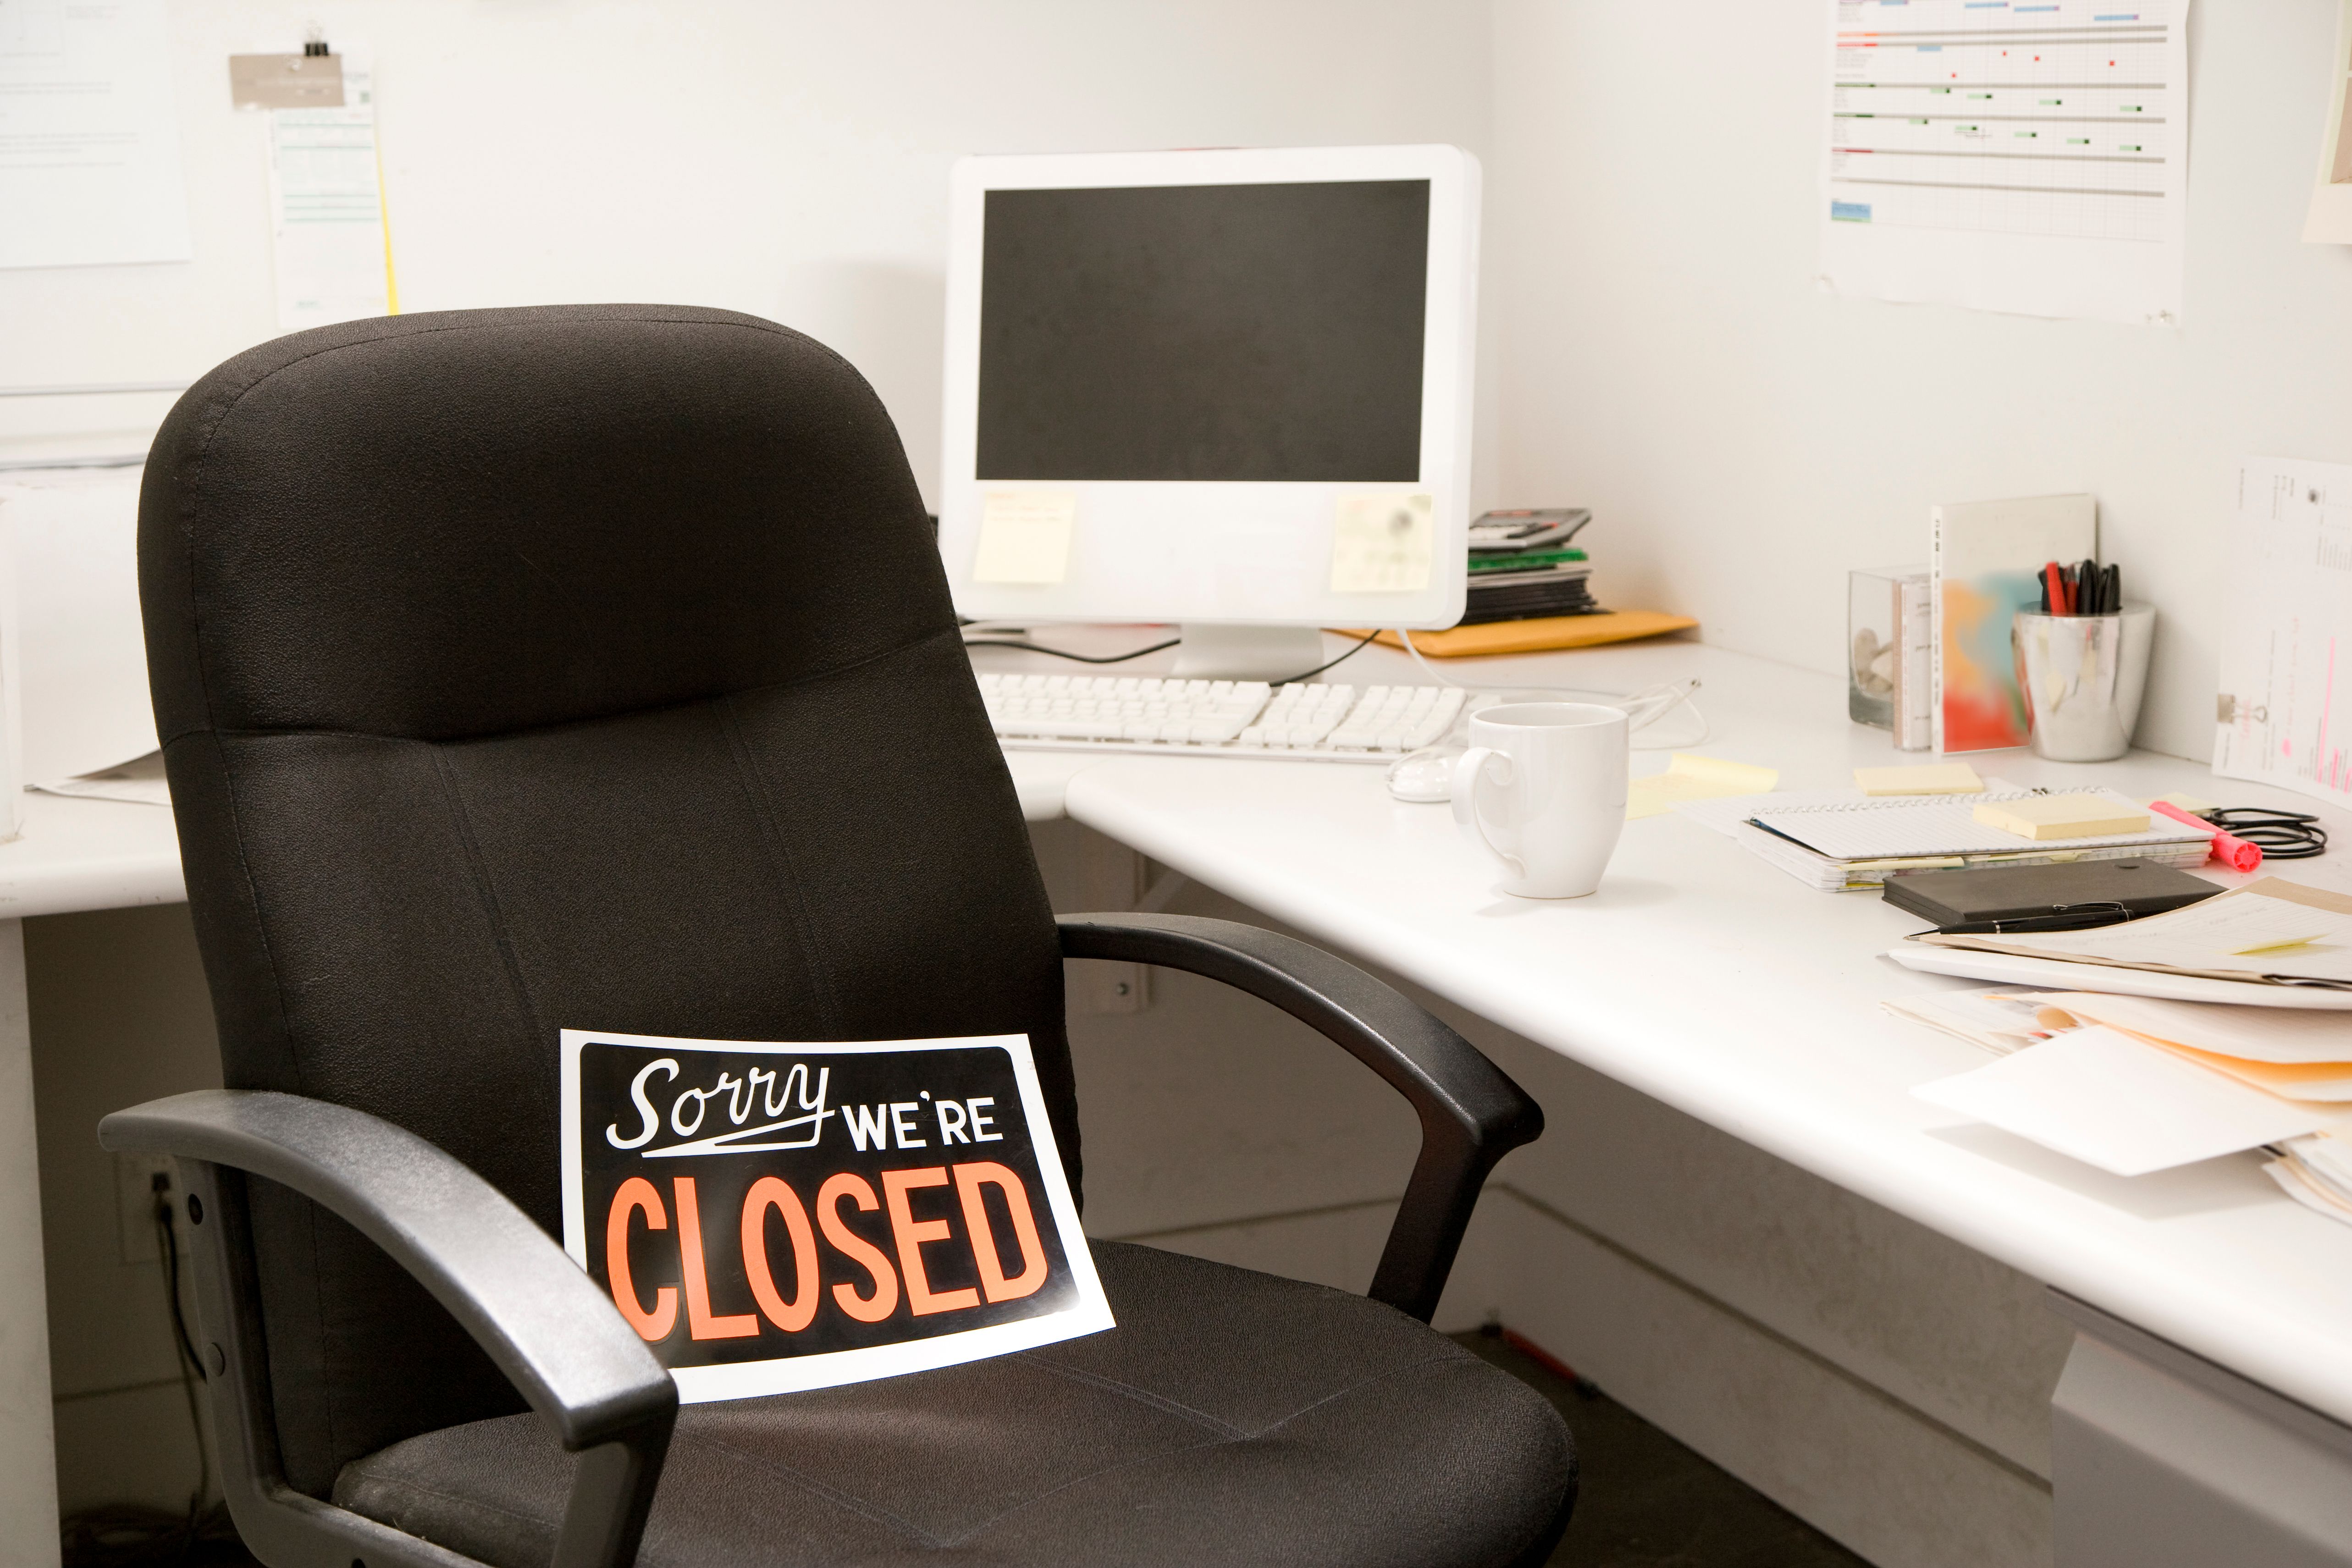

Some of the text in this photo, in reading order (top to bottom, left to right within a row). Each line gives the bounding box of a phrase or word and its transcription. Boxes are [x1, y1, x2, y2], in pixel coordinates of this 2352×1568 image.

[606, 1058, 1004, 1159] Sorry WE'RE
[606, 1161, 1049, 1342] CLOSED
